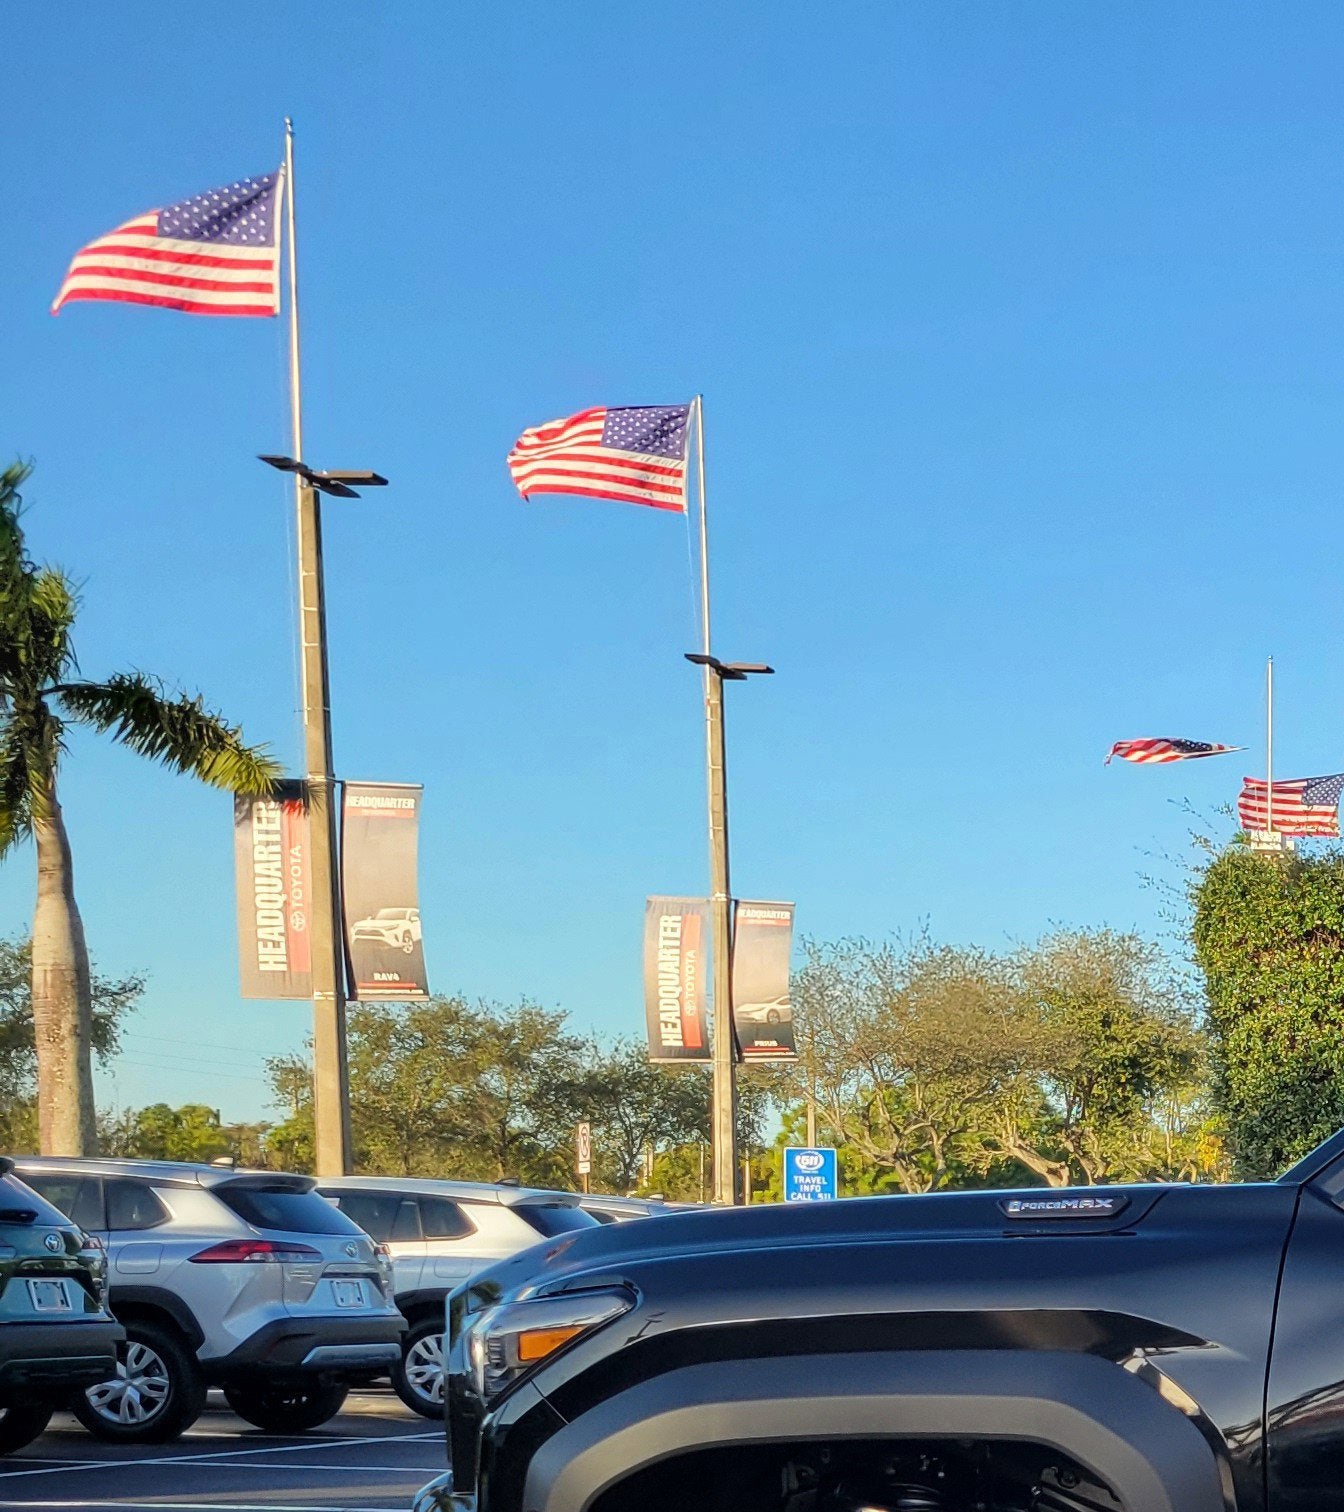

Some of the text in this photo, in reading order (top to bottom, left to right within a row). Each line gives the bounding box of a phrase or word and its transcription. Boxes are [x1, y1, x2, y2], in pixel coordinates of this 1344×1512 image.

[347, 796, 415, 809] HEADQUARTER
[290, 845, 301, 913] TOYOTA
[253, 801, 287, 971] HEADQUARTER
[373, 972, 400, 981] RAV4
[684, 949, 697, 997] TOYOTA
[658, 915, 683, 1046] HEADQUARTER
[793, 1175, 828, 1185] TRAVEL
[800, 1184, 821, 1193] INFO
[790, 1192, 812, 1201] CALL
